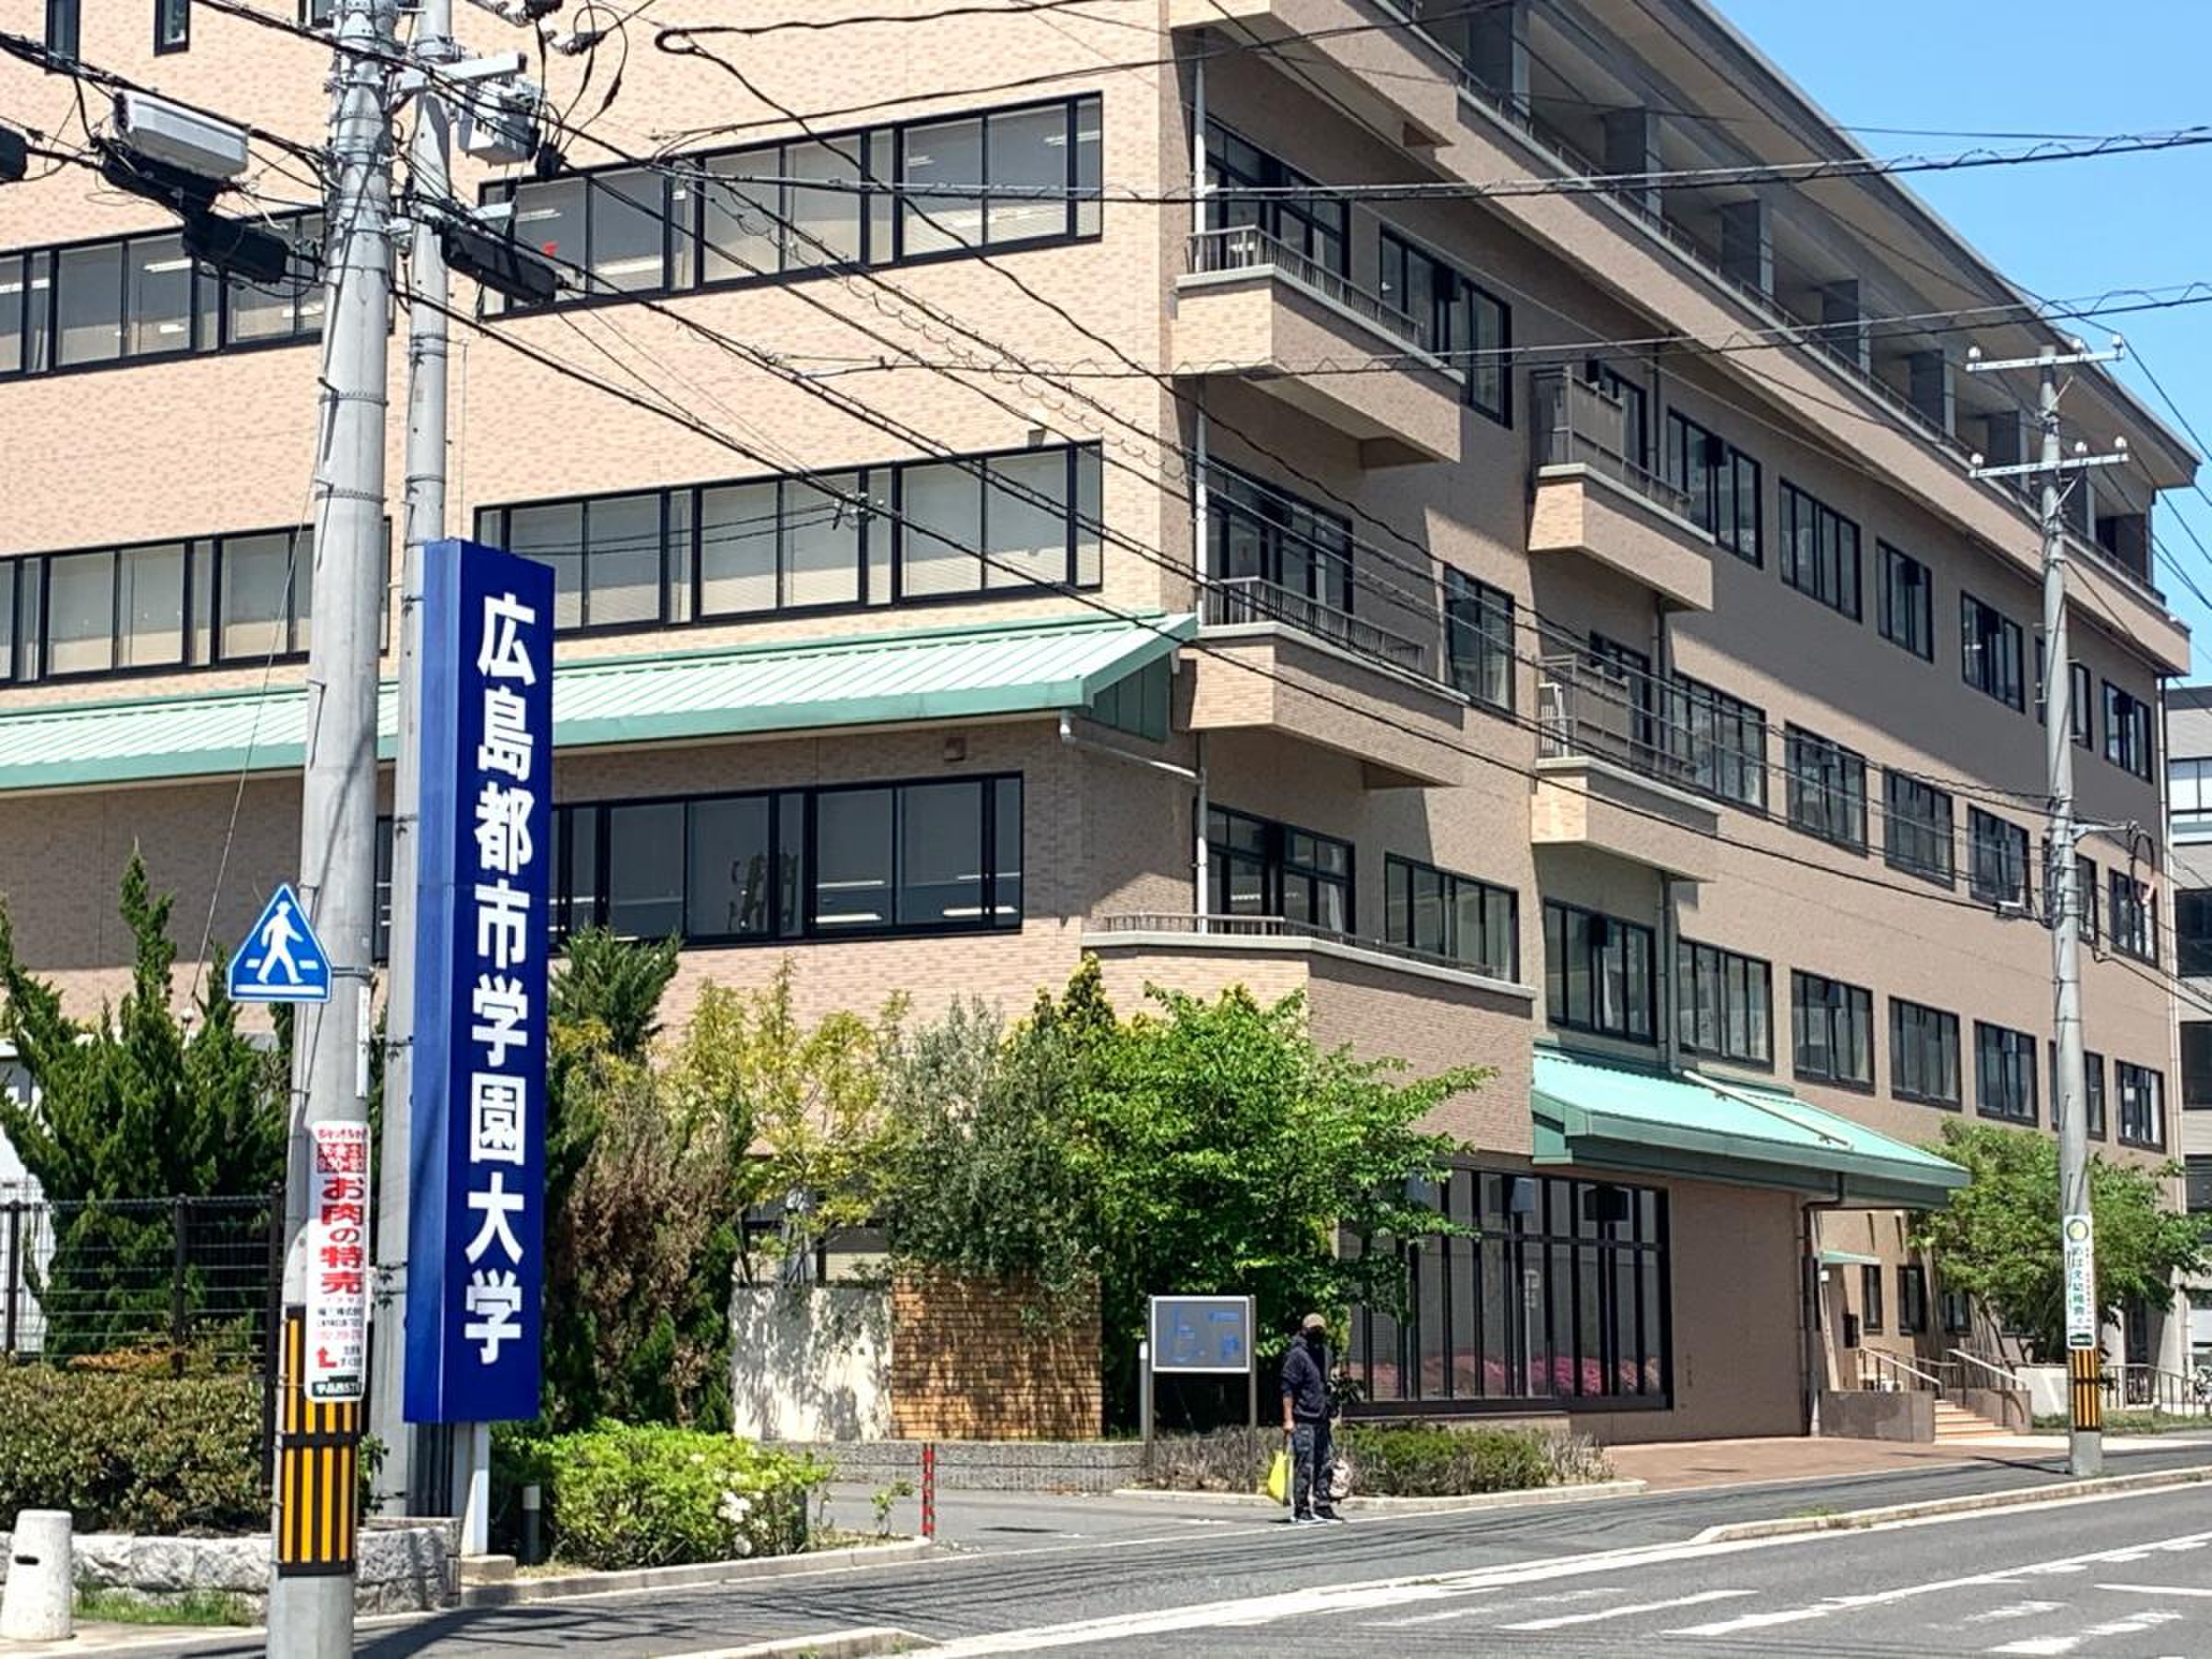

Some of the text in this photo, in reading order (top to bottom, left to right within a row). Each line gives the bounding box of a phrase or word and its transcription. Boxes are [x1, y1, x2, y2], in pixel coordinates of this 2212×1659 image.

[465, 593, 535, 1364] 広島都市学園大学
[321, 1177, 364, 1294] お肉の特売
